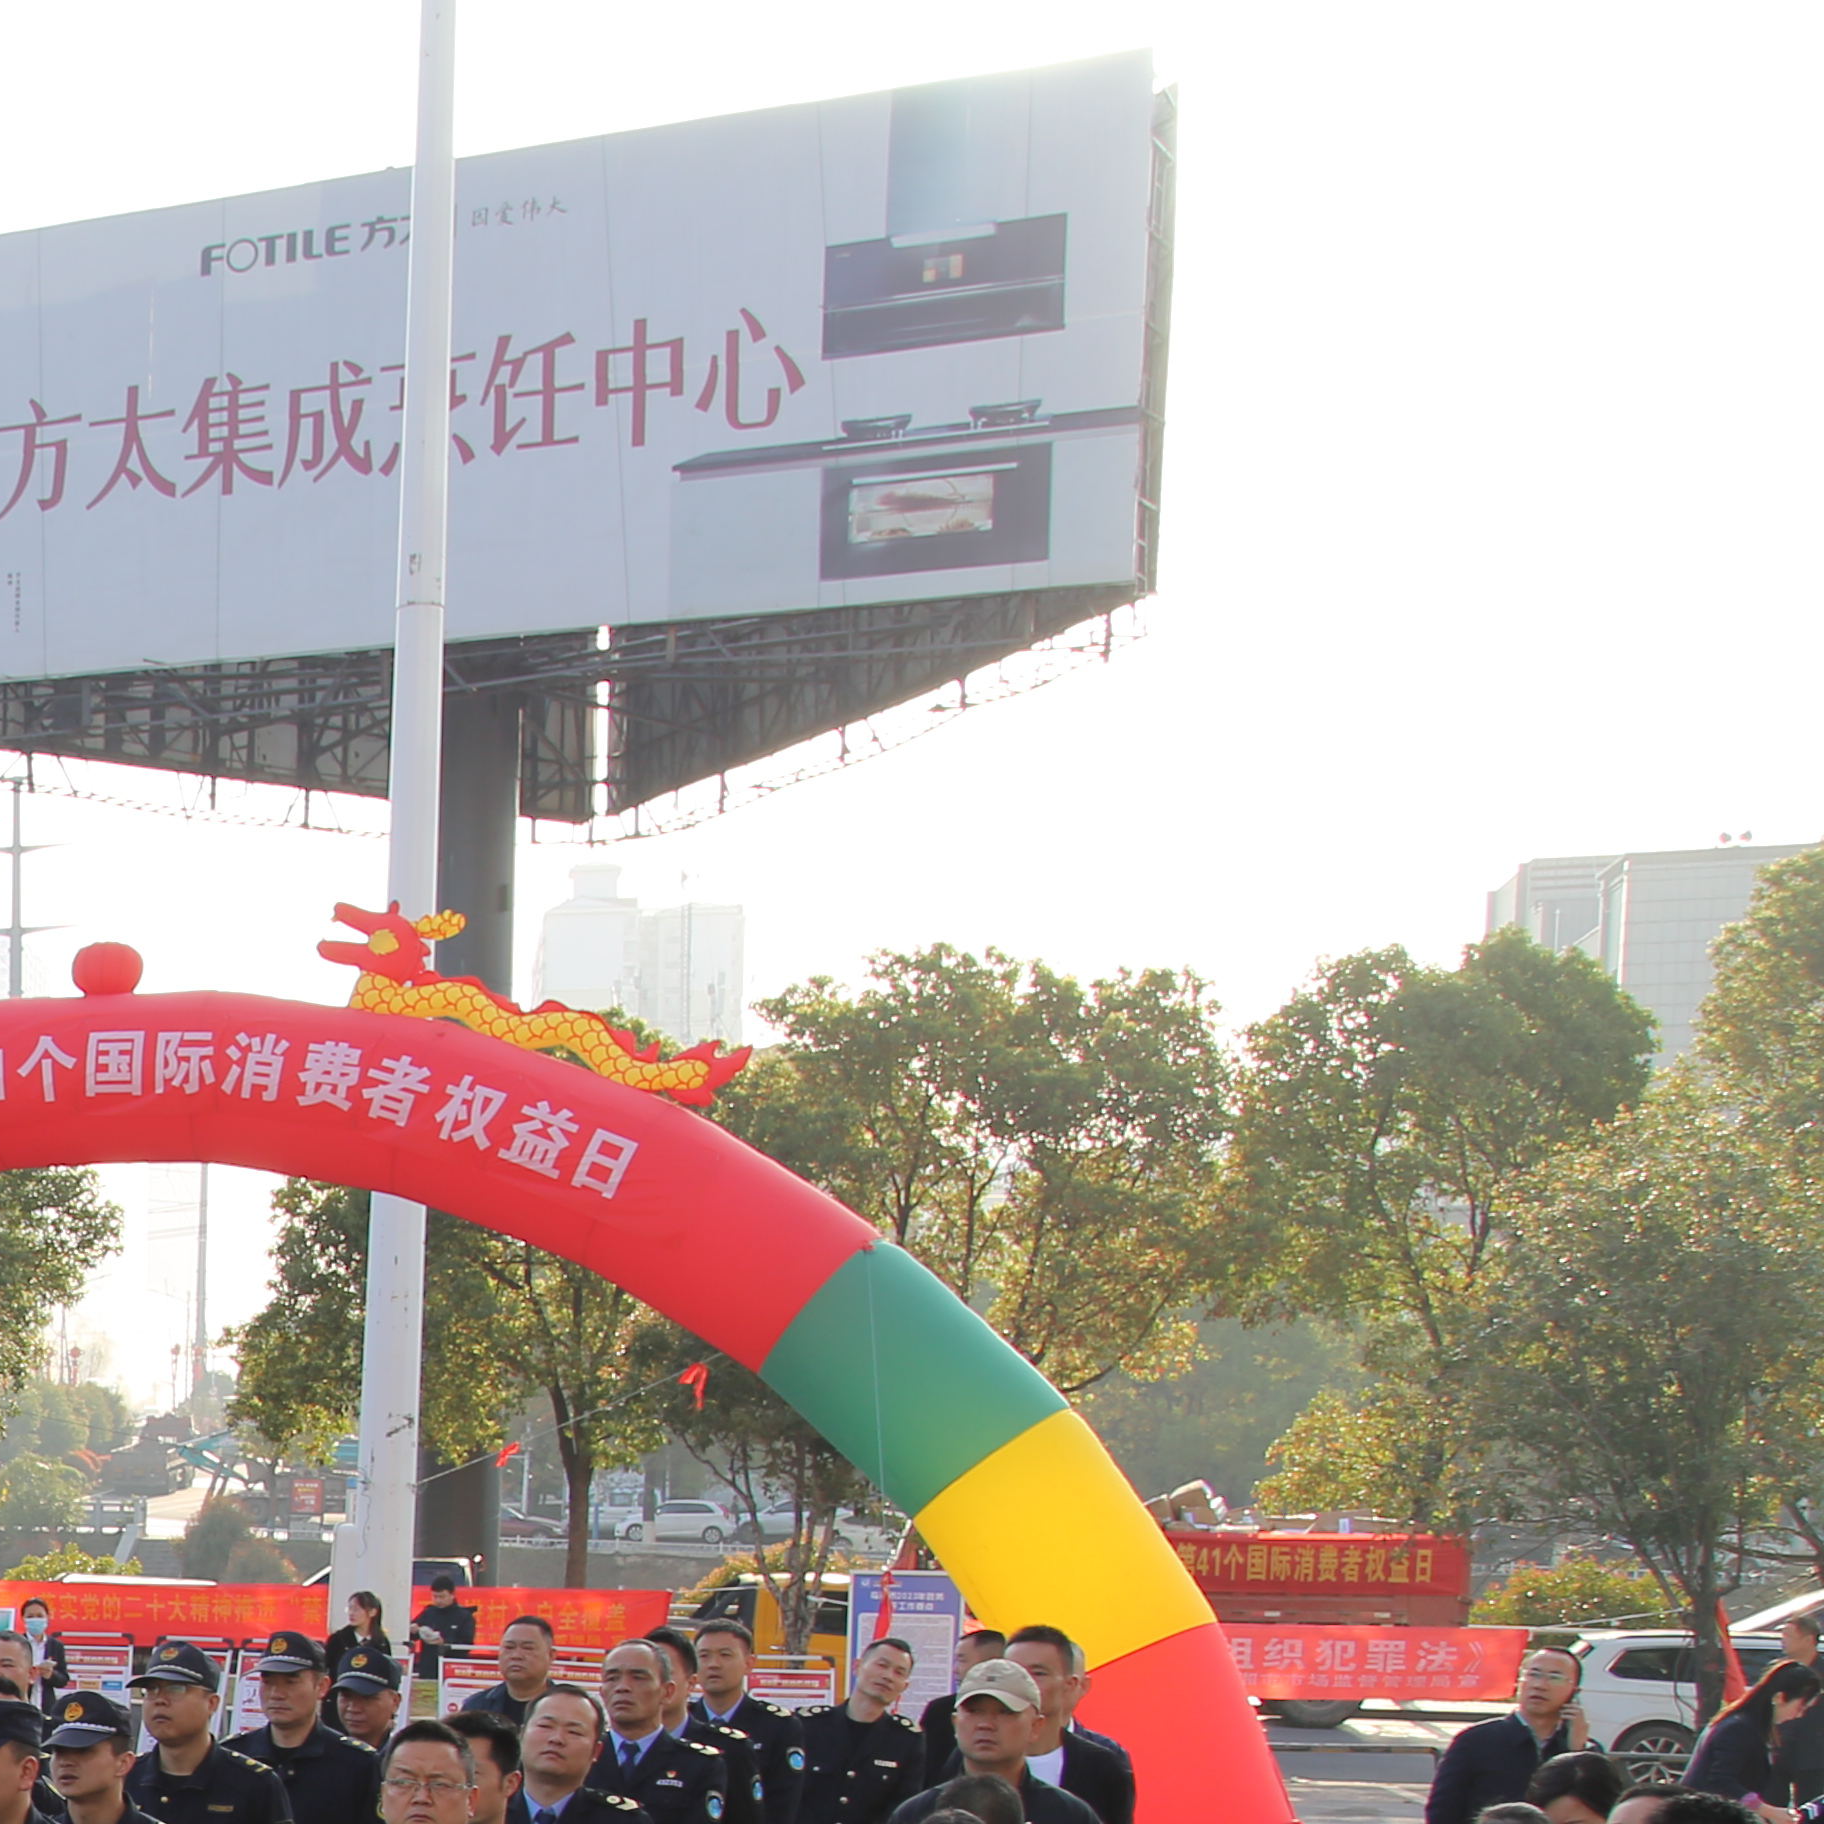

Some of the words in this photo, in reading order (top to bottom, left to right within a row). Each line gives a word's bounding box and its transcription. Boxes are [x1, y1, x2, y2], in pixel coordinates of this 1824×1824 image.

[200, 223, 352, 276] FOTILE
[360, 213, 412, 252] 方
[1178, 1544, 1434, 1584] 第41个国际消费者权益日
